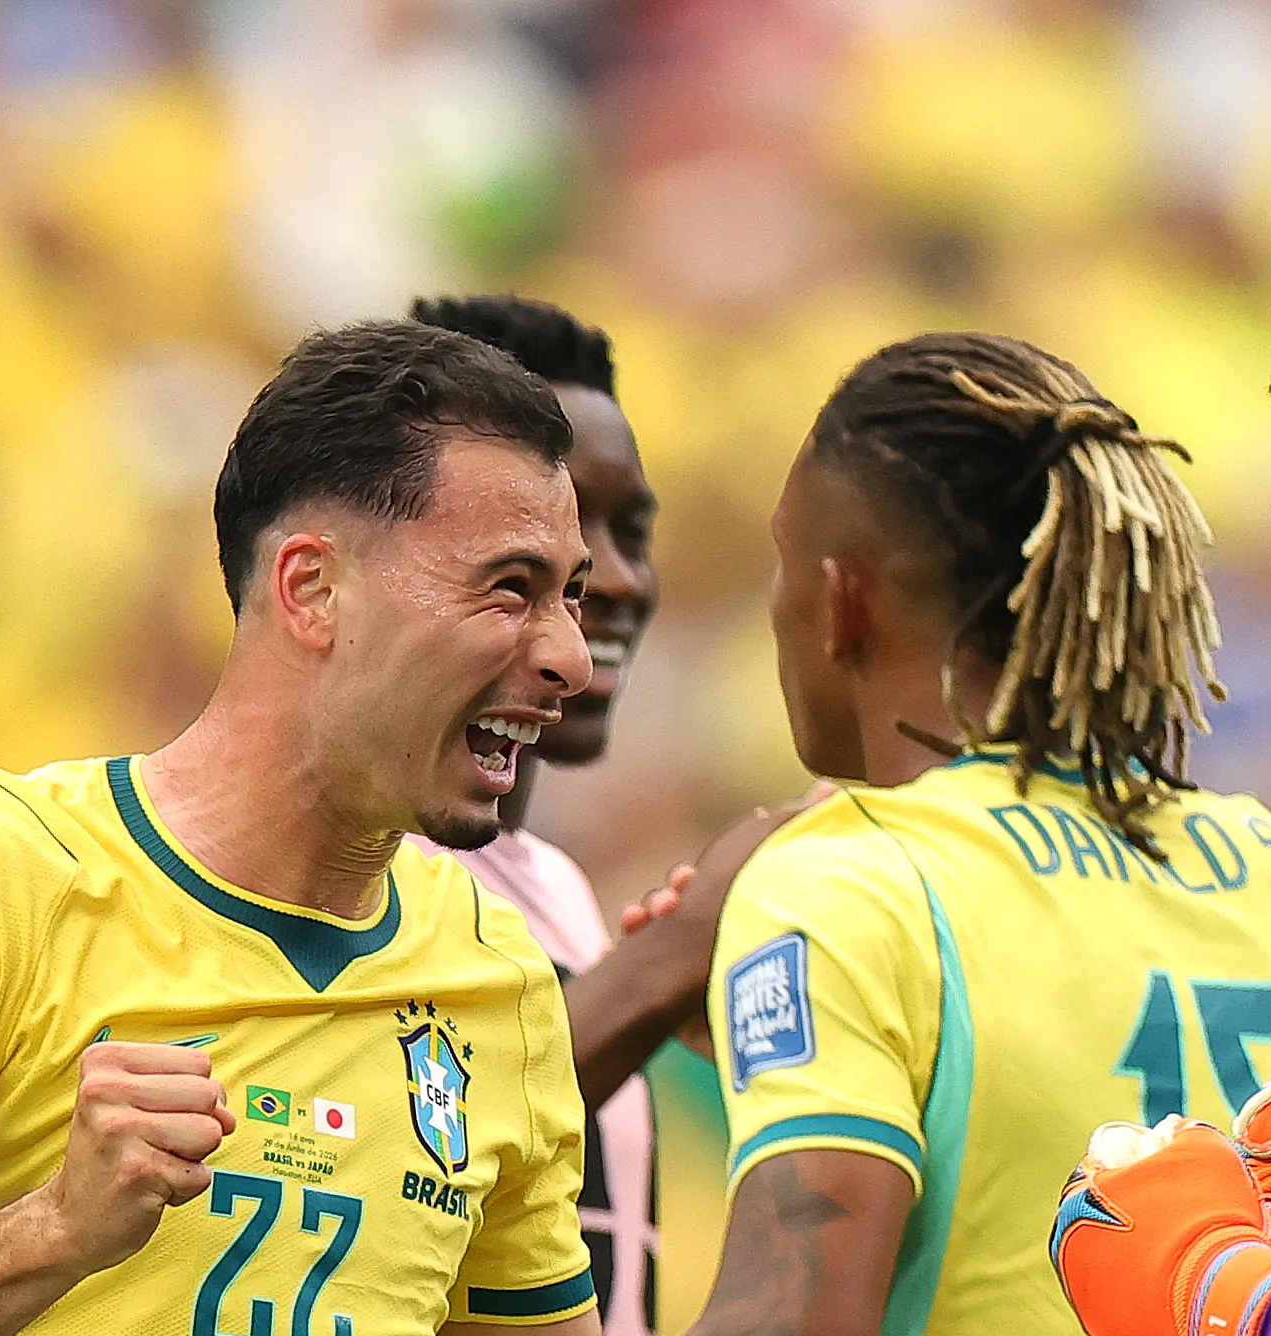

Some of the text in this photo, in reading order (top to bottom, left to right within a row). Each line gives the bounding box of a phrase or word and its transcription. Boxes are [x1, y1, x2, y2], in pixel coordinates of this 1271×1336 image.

[986, 803, 1250, 893] DANLO
[426, 1083, 451, 1110] CBF
[263, 1151, 294, 1167] BRASIL
[402, 1170, 470, 1221] BRASIL
